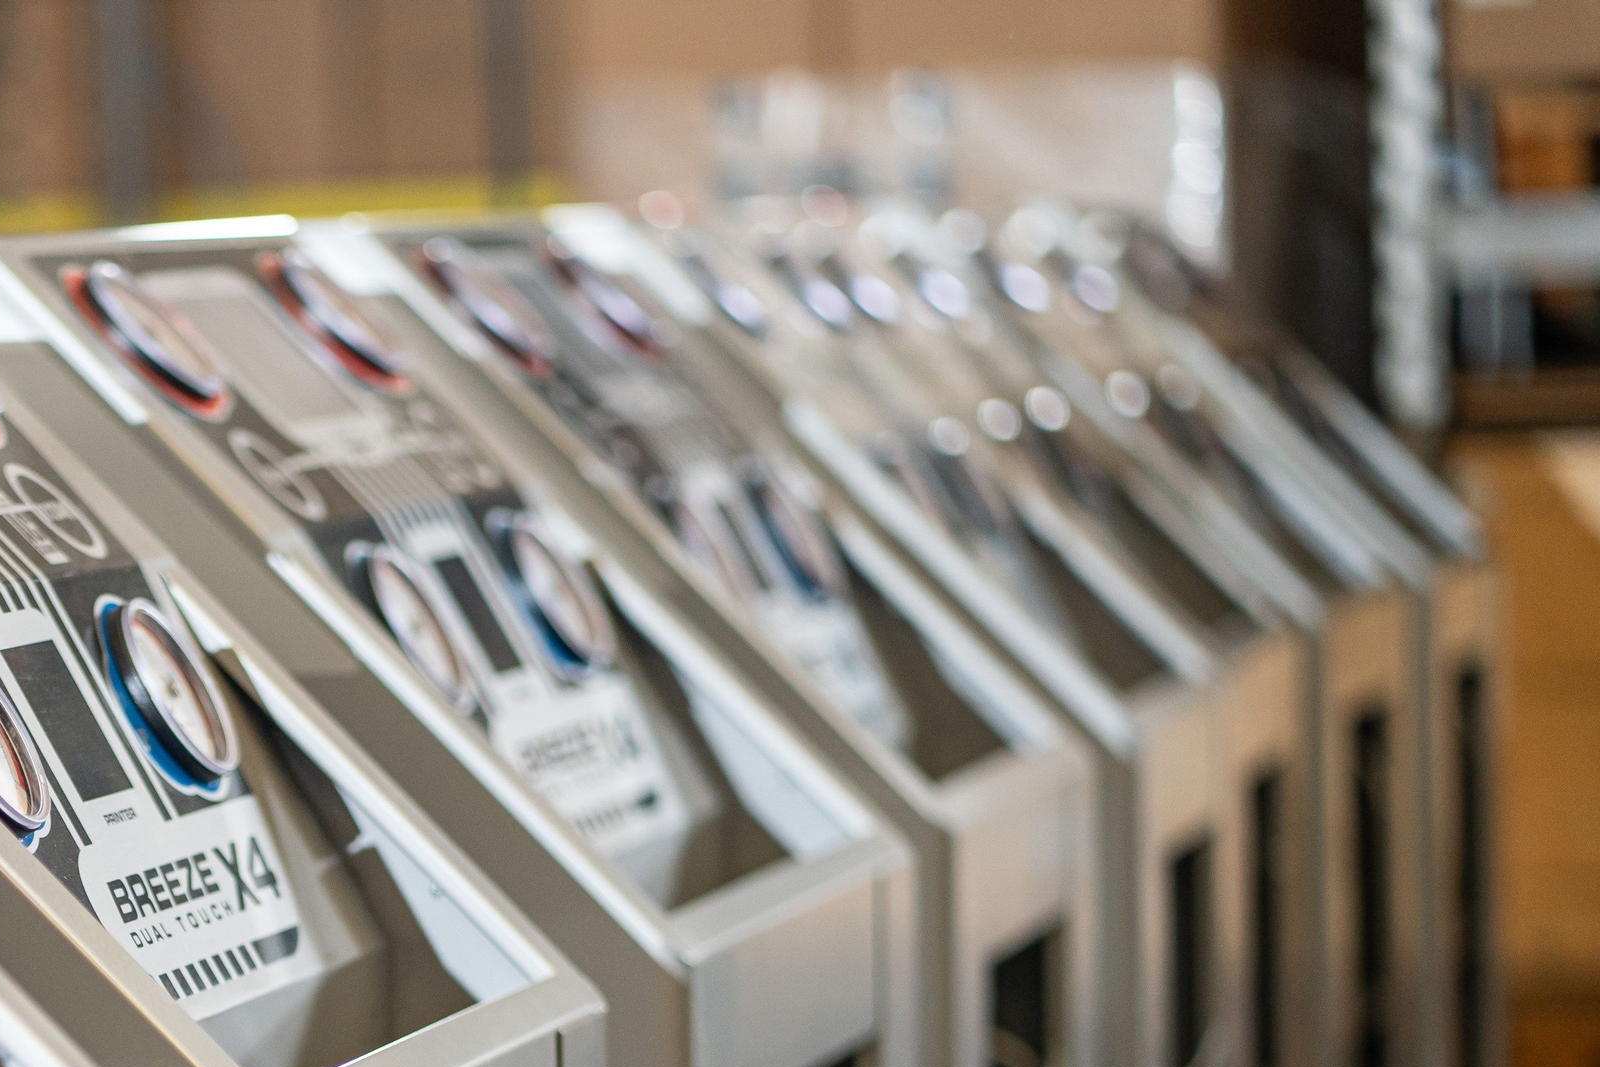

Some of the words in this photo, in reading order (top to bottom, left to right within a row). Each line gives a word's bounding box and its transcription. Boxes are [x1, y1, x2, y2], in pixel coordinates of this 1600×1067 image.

[103, 807, 137, 826] PRINTER
[106, 852, 220, 924] BREEZE
[211, 834, 282, 912] X4
[130, 922, 173, 949] DUAL
[175, 900, 234, 932] TOUCH
